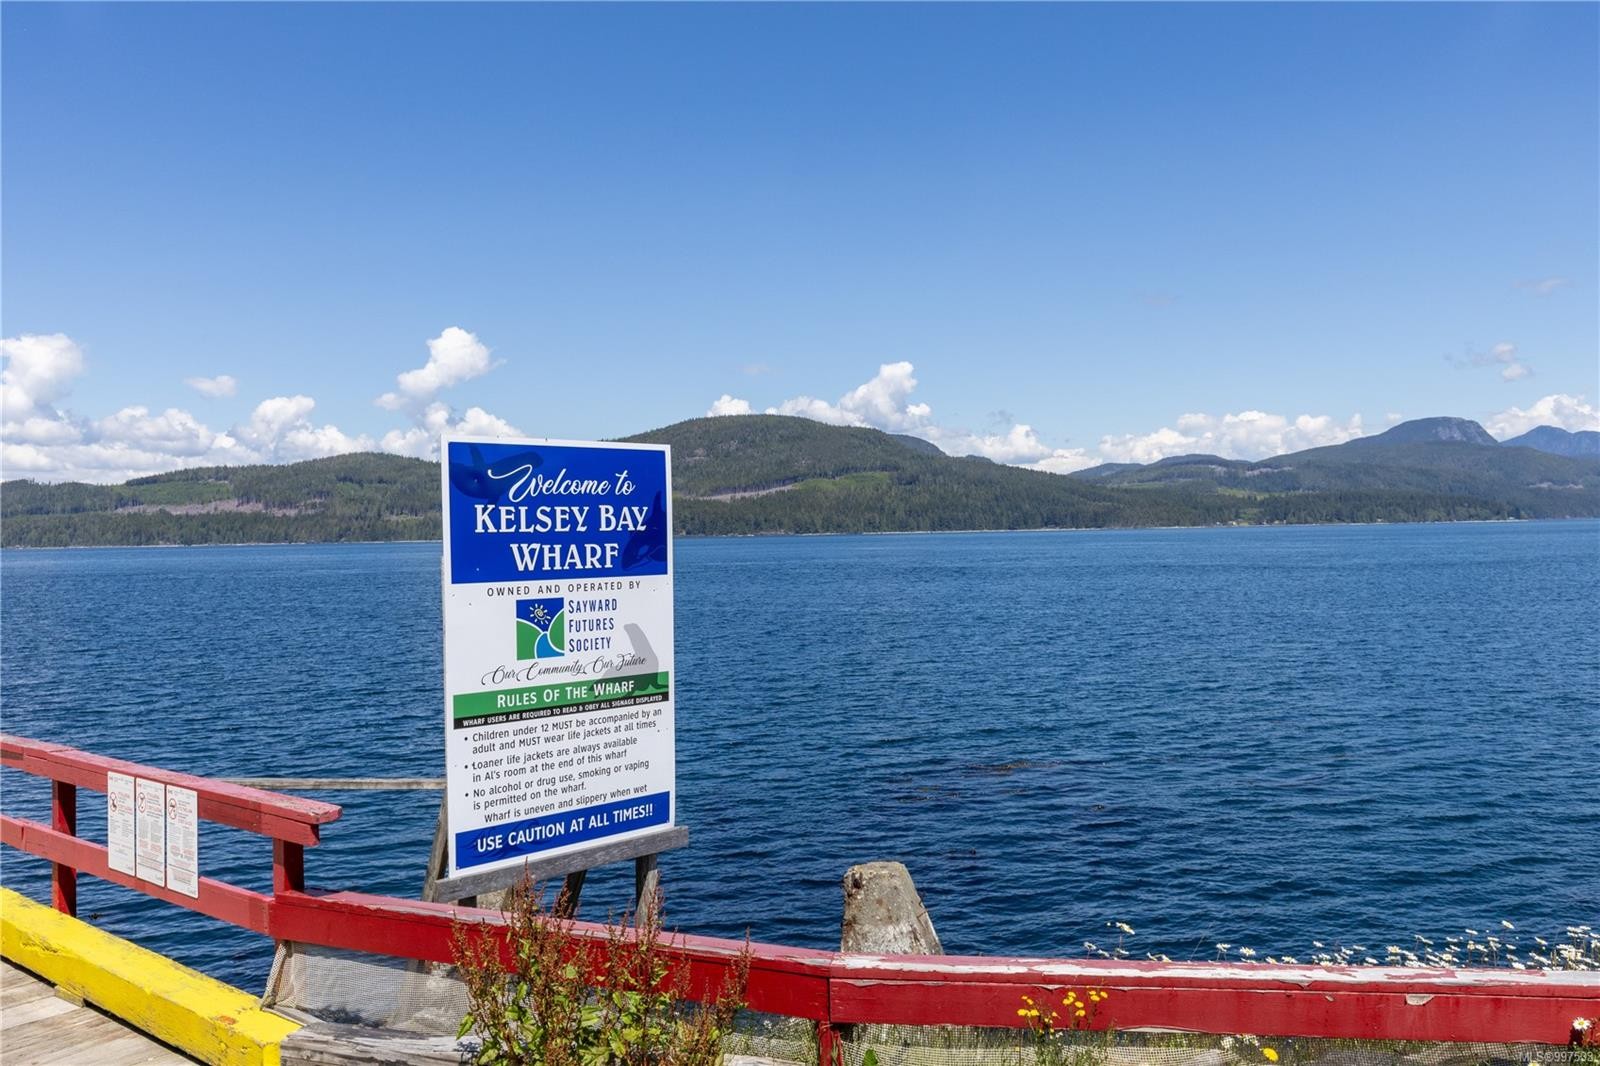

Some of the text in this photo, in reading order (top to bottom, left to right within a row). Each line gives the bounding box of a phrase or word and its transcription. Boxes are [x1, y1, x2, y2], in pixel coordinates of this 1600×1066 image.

[487, 464, 636, 502] Welcome to
[474, 504, 648, 533] KELSEY BAY
[510, 543, 619, 571] WHARF
[488, 581, 640, 596] OWNED AND OPERATED BY
[569, 599, 617, 613] SAYWARD
[569, 618, 614, 633] FUTURES
[569, 637, 611, 652] SOCIETY
[481, 665, 516, 685] Our
[583, 656, 613, 674] Our
[616, 653, 646, 671] Future
[463, 718, 485, 727] WHARF
[522, 710, 551, 719] REQUIRED
[563, 706, 577, 714] READ
[585, 702, 599, 710] OBEY
[612, 698, 634, 707] SIGNAGE
[636, 694, 663, 704] DISPLAYED
[497, 681, 635, 708] RULES OF THE WHARF
[472, 729, 509, 742] Children
[513, 726, 538, 736] under
[552, 720, 572, 731] MUST
[576, 718, 586, 727] be
[589, 710, 639, 726] accompanied
[642, 709, 651, 719] by
[472, 743, 495, 754] adult
[499, 740, 516, 750] and
[519, 736, 540, 746] MUST
[544, 734, 564, 743] wear
[568, 730, 580, 740] life
[583, 726, 611, 740] jackets
[624, 722, 634, 731] all
[636, 719, 656, 728] times
[472, 736, 638, 770] Loaner life jackets are always available
[472, 750, 627, 782] in Al's room at the end of this wharf
[473, 788, 485, 798] No
[489, 782, 522, 796] alcohol
[537, 777, 556, 788] drug
[559, 774, 575, 784] use,
[578, 766, 610, 780] smoking
[625, 760, 650, 772] vaping
[473, 783, 586, 810] is permitted on the wharf.
[484, 785, 648, 822] Wharf is uneven and slippery when wet
[477, 804, 653, 852] USE CAUTION AT ALL TIMES!!
